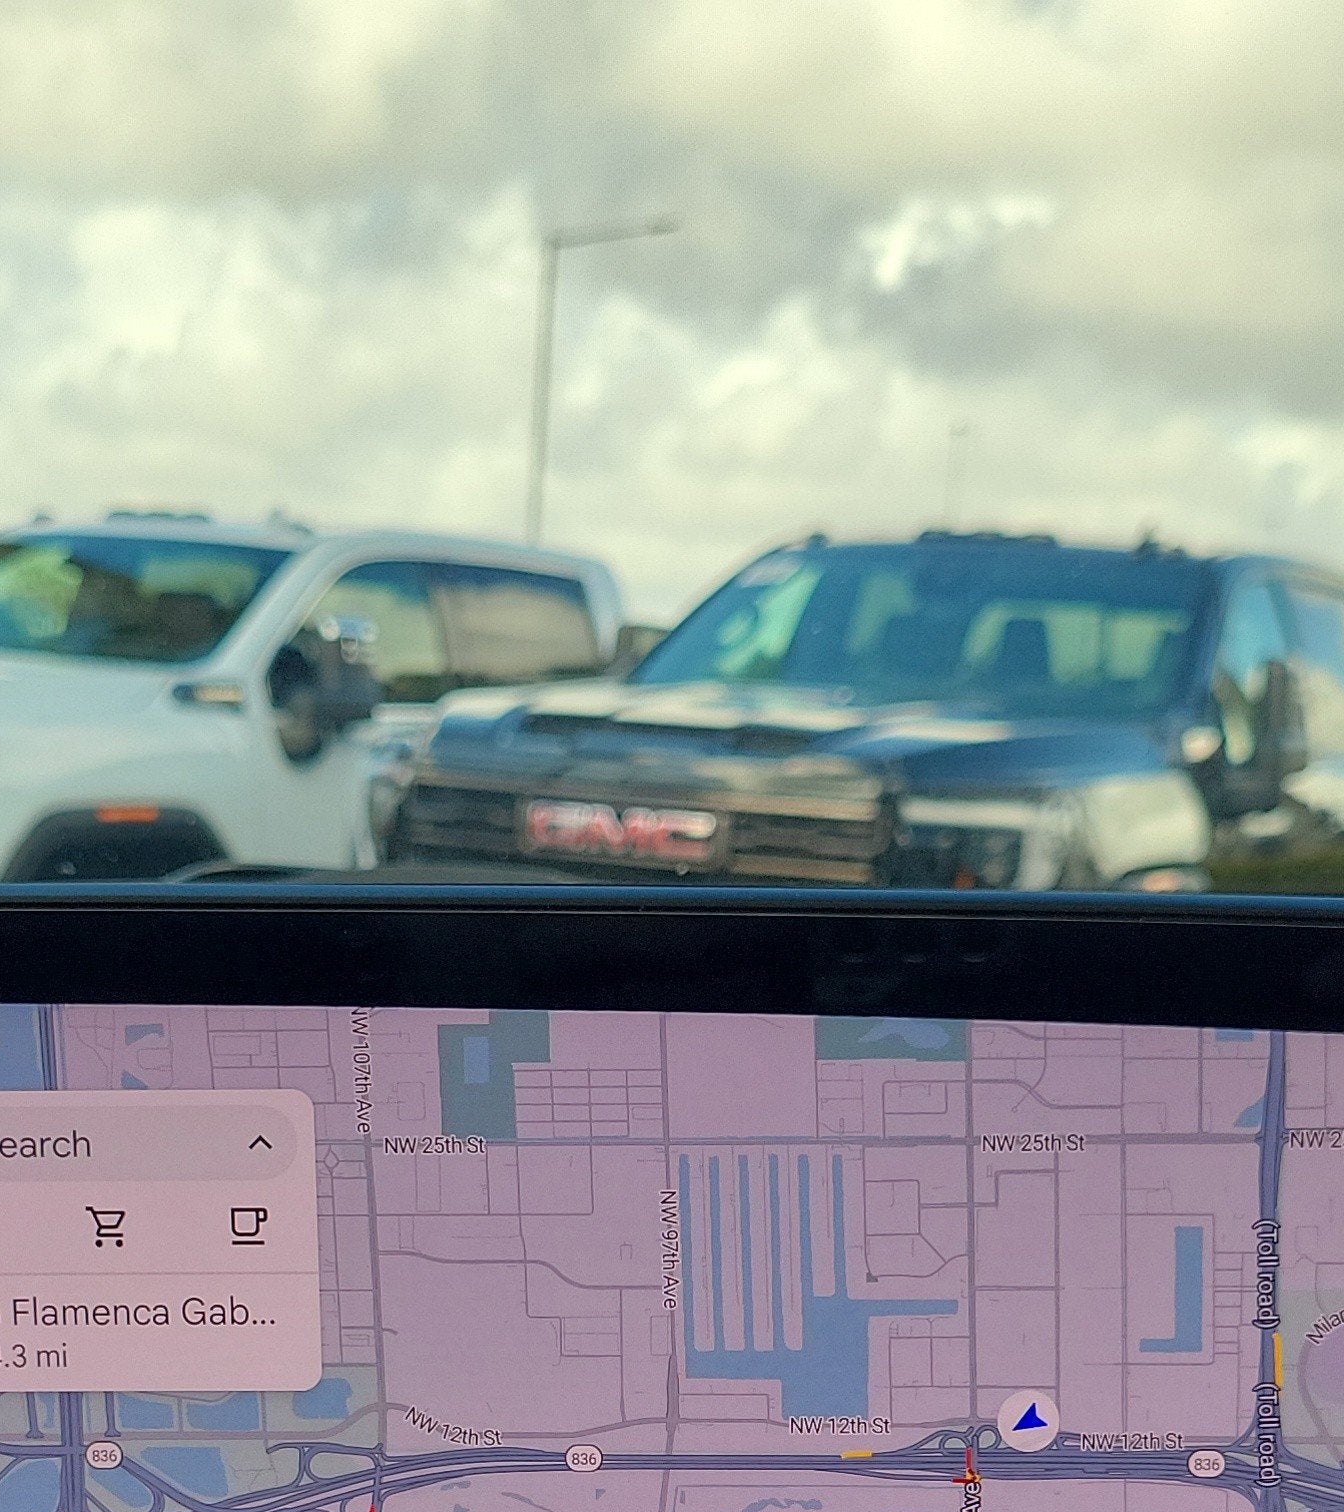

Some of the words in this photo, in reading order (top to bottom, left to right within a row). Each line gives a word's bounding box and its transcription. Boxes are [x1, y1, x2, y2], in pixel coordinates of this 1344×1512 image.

[353, 1041, 372, 1094] 107th
[356, 1099, 373, 1134] Ave
[384, 1138, 419, 1154] NW
[422, 1136, 463, 1154] 25th
[466, 1137, 487, 1154] St
[982, 1135, 1015, 1152] NW
[1020, 1134, 1062, 1152] 25th
[1066, 1135, 1086, 1152] St
[1289, 1131, 1324, 1148] NW
[660, 1189, 678, 1224] NW
[661, 1228, 680, 1273] 97th
[1252, 1219, 1281, 1268] (Toll
[663, 1275, 681, 1310] Ave
[1252, 1272, 1281, 1330] road)
[12, 1297, 170, 1327] Flamenca
[181, 1296, 276, 1327] Gab...
[36, 1344, 68, 1369] mi
[1252, 1382, 1281, 1428] (Toll
[404, 1406, 441, 1434] NW
[441, 1423, 480, 1446] 12th
[483, 1428, 503, 1446] St
[790, 1418, 823, 1434] NW
[828, 1417, 869, 1434] 12th
[873, 1418, 891, 1434] St
[1081, 1434, 1116, 1451] NW
[1122, 1433, 1161, 1450] 12th
[1165, 1433, 1184, 1450] St
[92, 1448, 118, 1463] 836
[571, 1453, 597, 1466] 836
[1194, 1458, 1220, 1472] 836
[1254, 1432, 1282, 1488] road)
